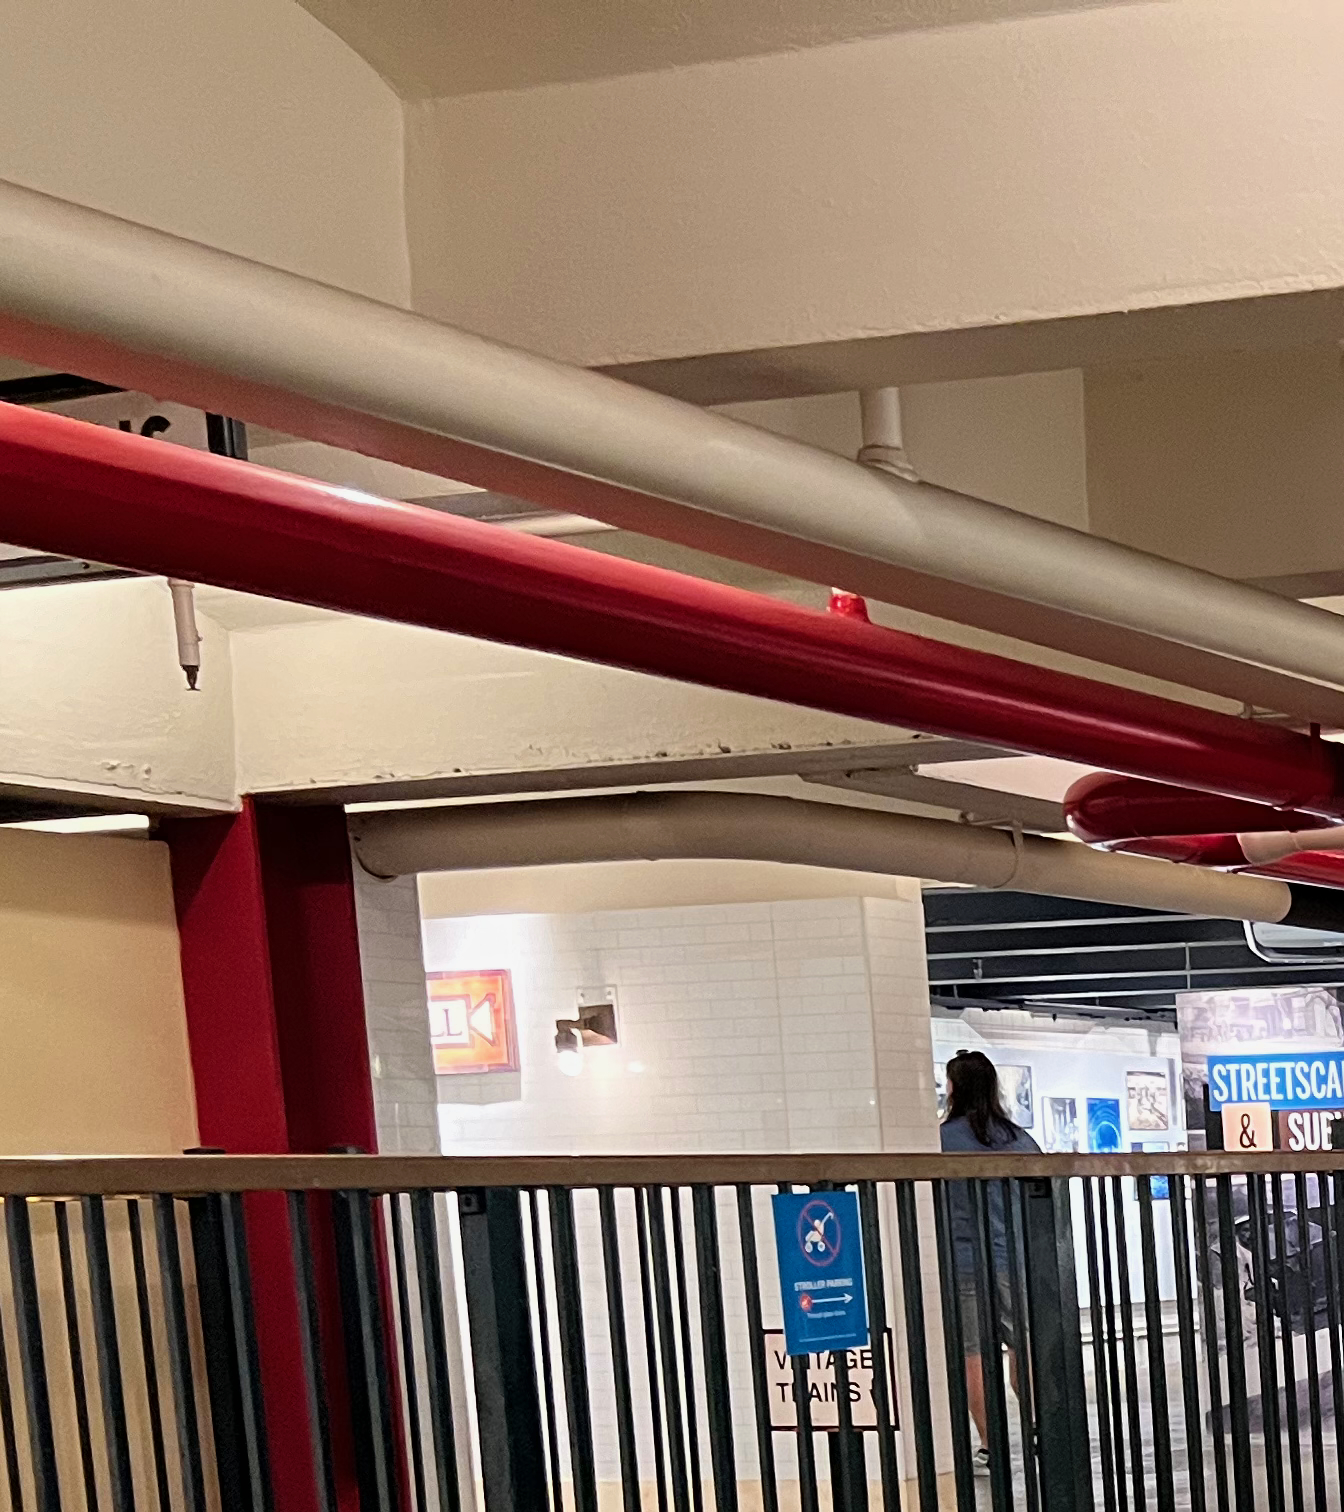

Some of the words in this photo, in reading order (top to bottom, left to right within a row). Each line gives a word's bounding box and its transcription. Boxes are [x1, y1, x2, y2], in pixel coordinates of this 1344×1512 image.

[1239, 1113, 1258, 1149] &
[794, 1279, 826, 1292] STROLLER
[826, 1277, 853, 1288] PARKING
